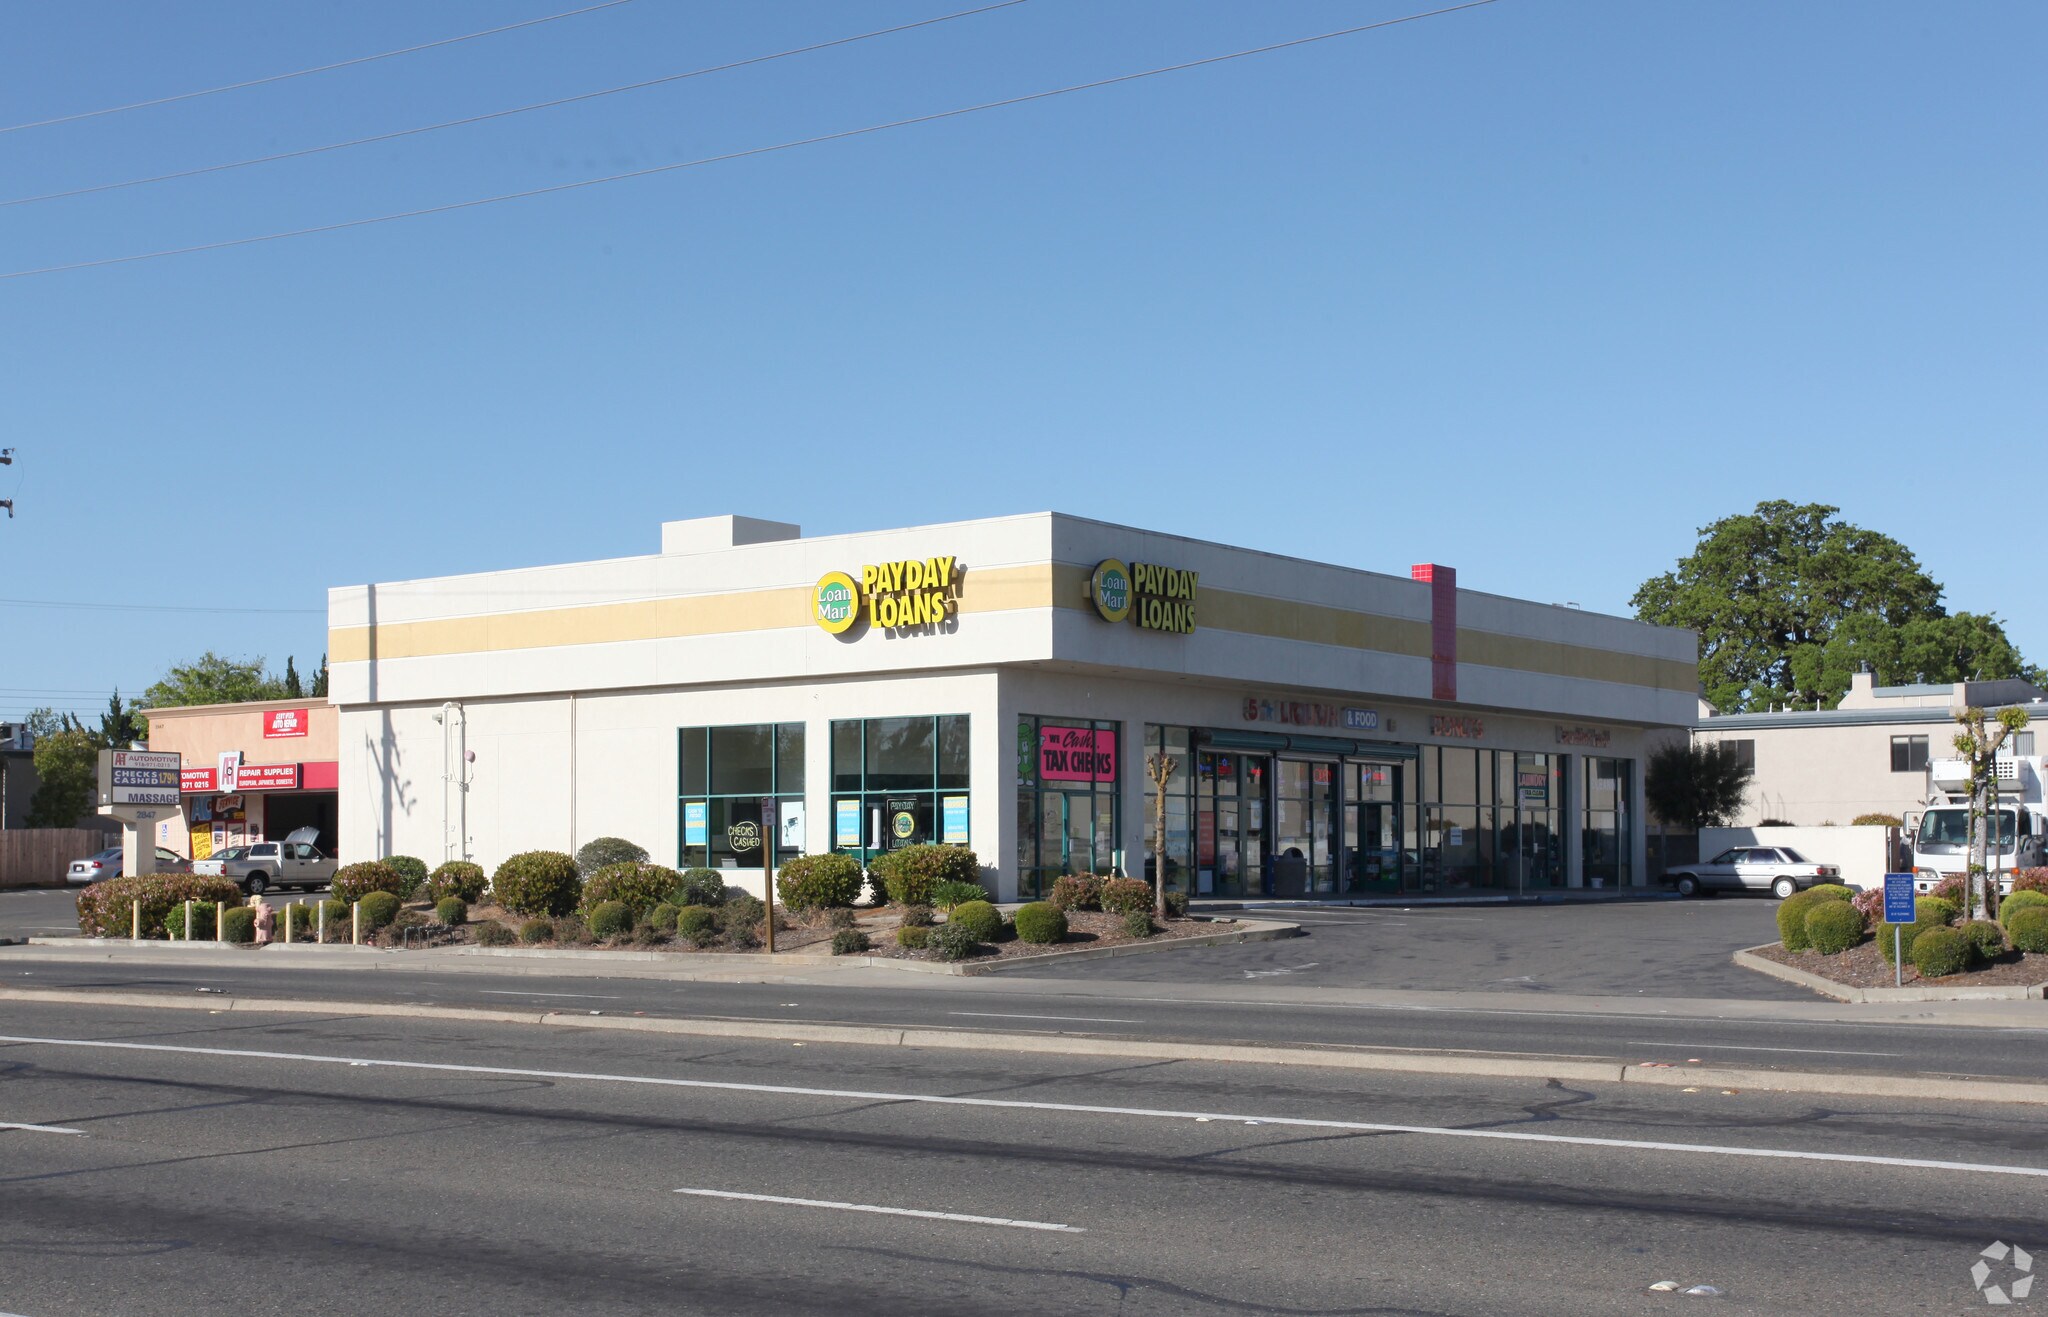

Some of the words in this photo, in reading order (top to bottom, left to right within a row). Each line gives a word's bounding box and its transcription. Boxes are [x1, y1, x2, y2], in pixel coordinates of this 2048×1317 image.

[862, 556, 953, 594] PAYDAY
[1100, 572, 1127, 590] Loan
[1135, 563, 1199, 600] PAYDAY
[817, 586, 851, 602] Loan
[1100, 590, 1128, 608] Mart
[817, 604, 852, 620] Mart
[869, 592, 944, 628] LOANS
[1142, 598, 1196, 634] LOANS
[1347, 711, 1353, 725] &
[1355, 712, 1377, 726] FOOD
[1049, 734, 1060, 743] WE
[1043, 750, 1069, 771] TAX
[239, 769, 261, 777] REPAIR
[264, 768, 294, 776] SUPPLIES
[1518, 773, 1546, 787] LAUNDRY
[128, 793, 178, 803] MASSAGE
[136, 811, 156, 819] 2847
[728, 826, 754, 836] CHECKS
[733, 837, 760, 847] CASHED
